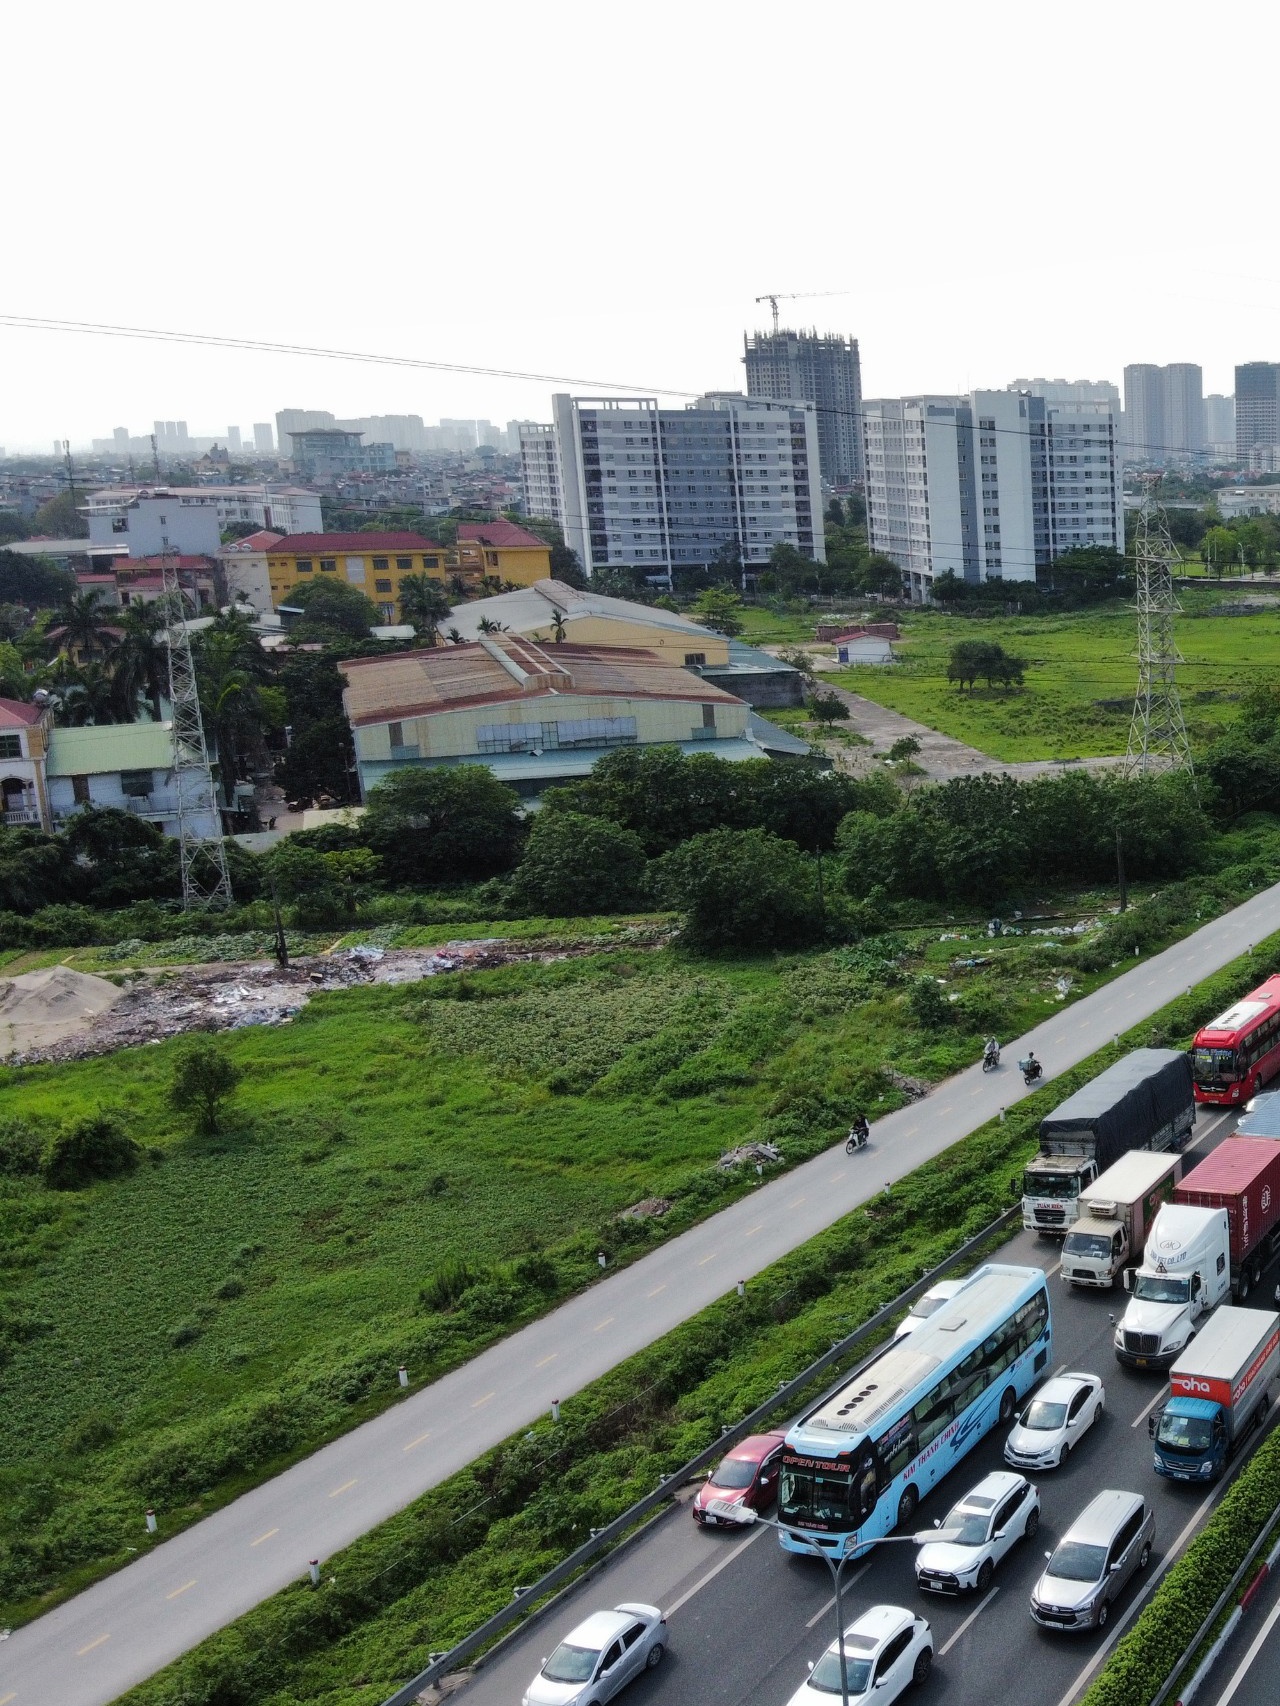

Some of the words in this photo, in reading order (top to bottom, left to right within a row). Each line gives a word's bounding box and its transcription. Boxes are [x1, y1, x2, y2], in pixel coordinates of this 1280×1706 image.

[782, 1455, 815, 1468] OPEN
[815, 1460, 851, 1472] TOUR
[903, 1462, 917, 1481] KIM
